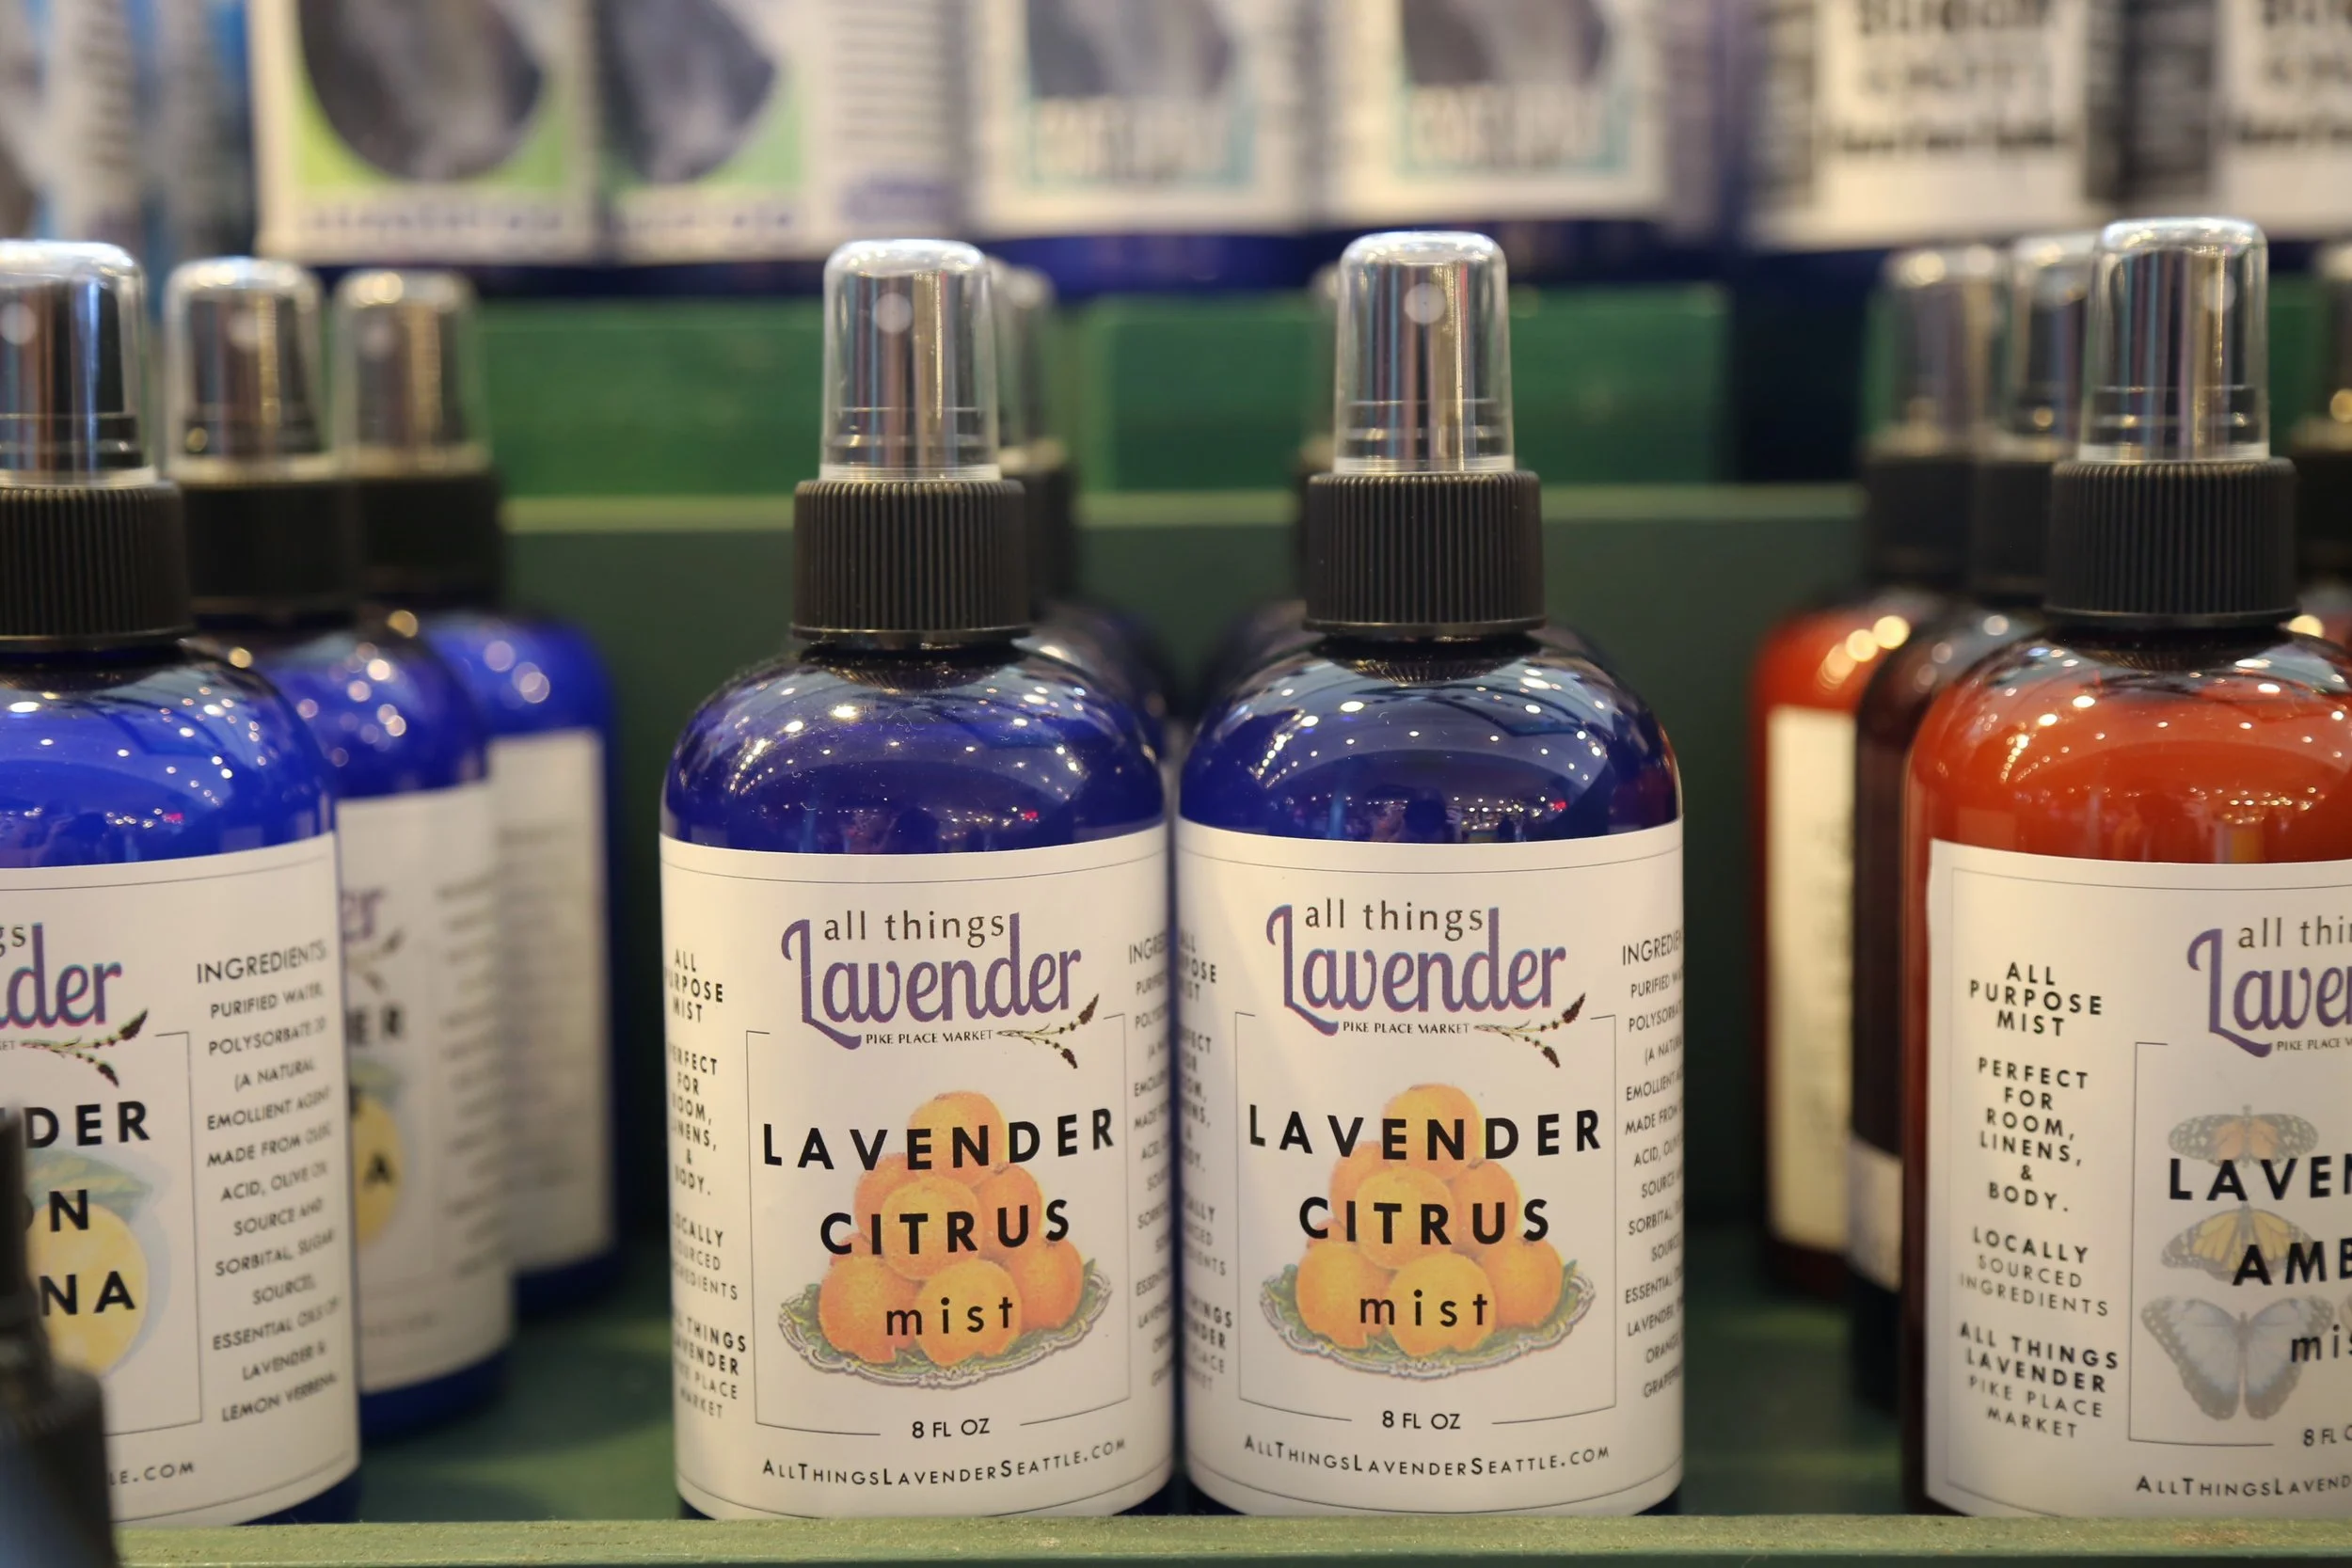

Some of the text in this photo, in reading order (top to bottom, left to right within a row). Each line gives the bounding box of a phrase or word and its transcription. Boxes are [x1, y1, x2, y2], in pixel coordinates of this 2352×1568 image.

[823, 910, 1006, 948] all things
[1305, 896, 1484, 942] all things
[2237, 916, 2283, 949] all
[0, 922, 122, 1029] der
[674, 948, 697, 973] ALL
[1265, 904, 1566, 1037] Lavender
[2006, 962, 2056, 987] ALL
[781, 912, 1081, 1051] Lavender
[1630, 974, 1670, 999] PURIFIED
[1970, 979, 2103, 1016] PURPOSE
[210, 992, 278, 1019] PURIFIED
[672, 996, 703, 1023] MIST
[1629, 998, 1684, 1033] POLYSORBAT
[865, 1028, 993, 1045] PIKE PLACE MARKET
[1342, 1020, 1470, 1035] PIKE PLACE MARKET
[1996, 1010, 2065, 1037] MIST
[2276, 1038, 2304, 1052] PIKE
[2307, 1037, 2342, 1051] PLACE
[257, 1056, 316, 1084] NATURAL
[676, 1070, 700, 1097] FOR
[1626, 1072, 1675, 1101] EMOLLIENT
[1979, 1056, 2089, 1089] PERFECT
[2004, 1086, 2054, 1110] FOR
[24, 1100, 151, 1149] DER
[207, 1099, 294, 1131] EMOLLIENT
[1625, 1112, 1657, 1136] MADE
[1659, 1103, 1677, 1124] FROM
[1986, 1107, 2074, 1141] ROOM,
[671, 1118, 718, 1153] NENS,
[762, 1107, 1115, 1171] LAVENDER
[1248, 1103, 1601, 1162] LAVENDER
[1979, 1131, 2082, 1166] LINENS,
[206, 1144, 255, 1168] MADE
[261, 1133, 301, 1157] FROM
[1633, 1143, 1661, 1168] ACID,
[220, 1180, 266, 1203] ACID,
[270, 1164, 309, 1192] OLIVE
[2020, 1164, 2034, 1182] &
[1989, 1181, 2070, 1212] BODY.
[233, 1208, 295, 1237] SOURCE
[674, 1212, 723, 1248] OCALLY
[819, 1198, 1070, 1256] CITRUS
[1298, 1196, 1550, 1246] CITRUS
[1973, 1226, 2089, 1264] LOCALLY
[674, 1261, 739, 1302] GREDIENTS
[1979, 1254, 2083, 1289] SOURCED
[1625, 1275, 1673, 1306] ESSENTIAL
[1960, 1273, 2109, 1317] INGREDIENTS
[885, 1296, 1014, 1337] mist
[1359, 1289, 1489, 1327] mist
[213, 1318, 293, 1351] ESSENTIAL
[687, 1316, 746, 1353] THINGS
[1960, 1322, 2120, 1370] ALL THINGS
[242, 1343, 314, 1382] LAVENDER
[1966, 1349, 2106, 1394] LAVENDER
[694, 1370, 739, 1400] PLACE
[1969, 1375, 2104, 1418] PIKE PLACE
[221, 1393, 280, 1423] LEMON
[680, 1386, 723, 1419] MARKET
[911, 1418, 991, 1440] 8 FL OZ
[1381, 1410, 1461, 1430] 8 FL OZ
[1987, 1406, 2078, 1439] MARKET
[2303, 1428, 2315, 1447] 8
[2321, 1428, 2338, 1445] FL
